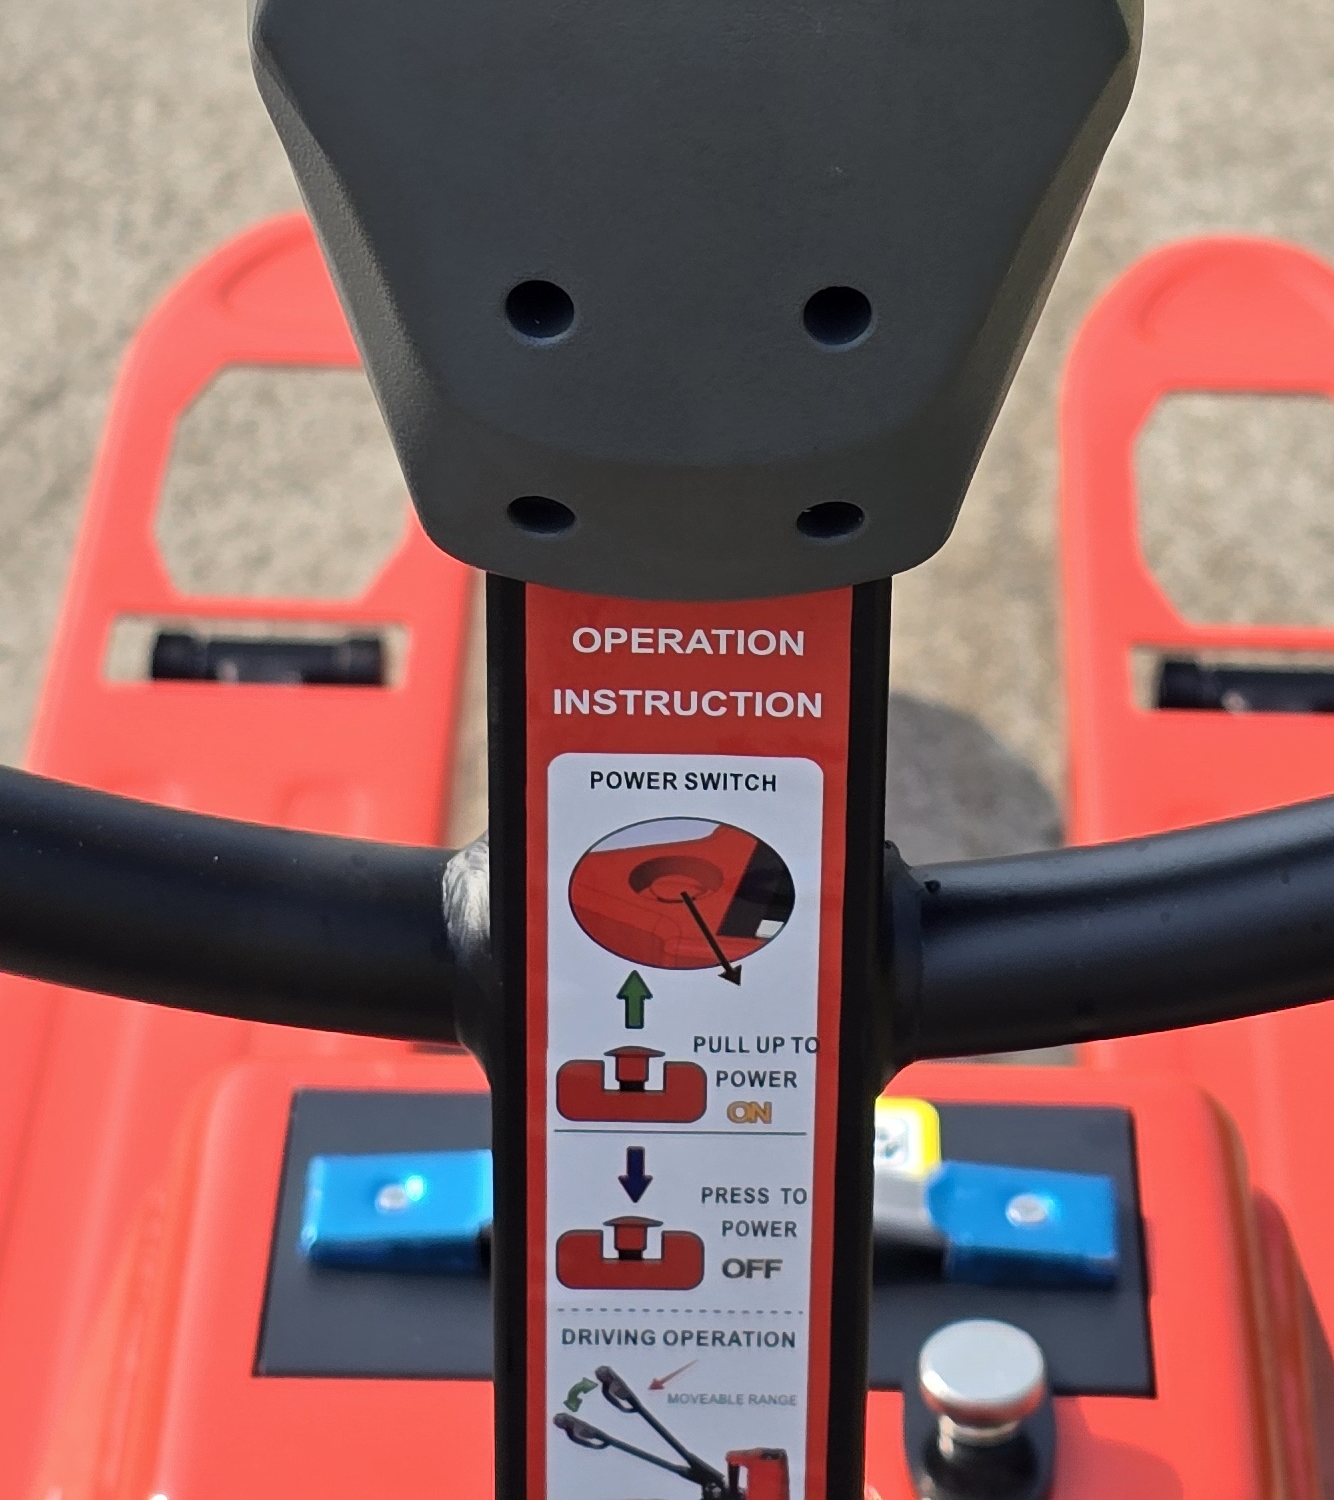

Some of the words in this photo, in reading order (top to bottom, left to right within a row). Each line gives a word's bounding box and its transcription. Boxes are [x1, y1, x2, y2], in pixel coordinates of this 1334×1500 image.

[572, 627, 805, 656] OPERATION
[553, 689, 822, 718] INSTRUCTION
[590, 770, 678, 791] POWER
[684, 771, 777, 792] SWITCH
[693, 1035, 750, 1054] PULL
[756, 1035, 785, 1054] UP
[791, 1036, 821, 1054] TO
[716, 1070, 798, 1088] POWER
[726, 1100, 773, 1125] ON
[701, 1186, 770, 1205] PRESS
[780, 1187, 808, 1205] TO
[721, 1220, 798, 1238] POWER
[721, 1257, 784, 1280] OFF
[561, 1327, 656, 1346] DRIVING
[662, 1328, 796, 1349] OPERATION
[667, 1392, 745, 1406] MOVEABLE
[748, 1393, 798, 1407] RANGE
